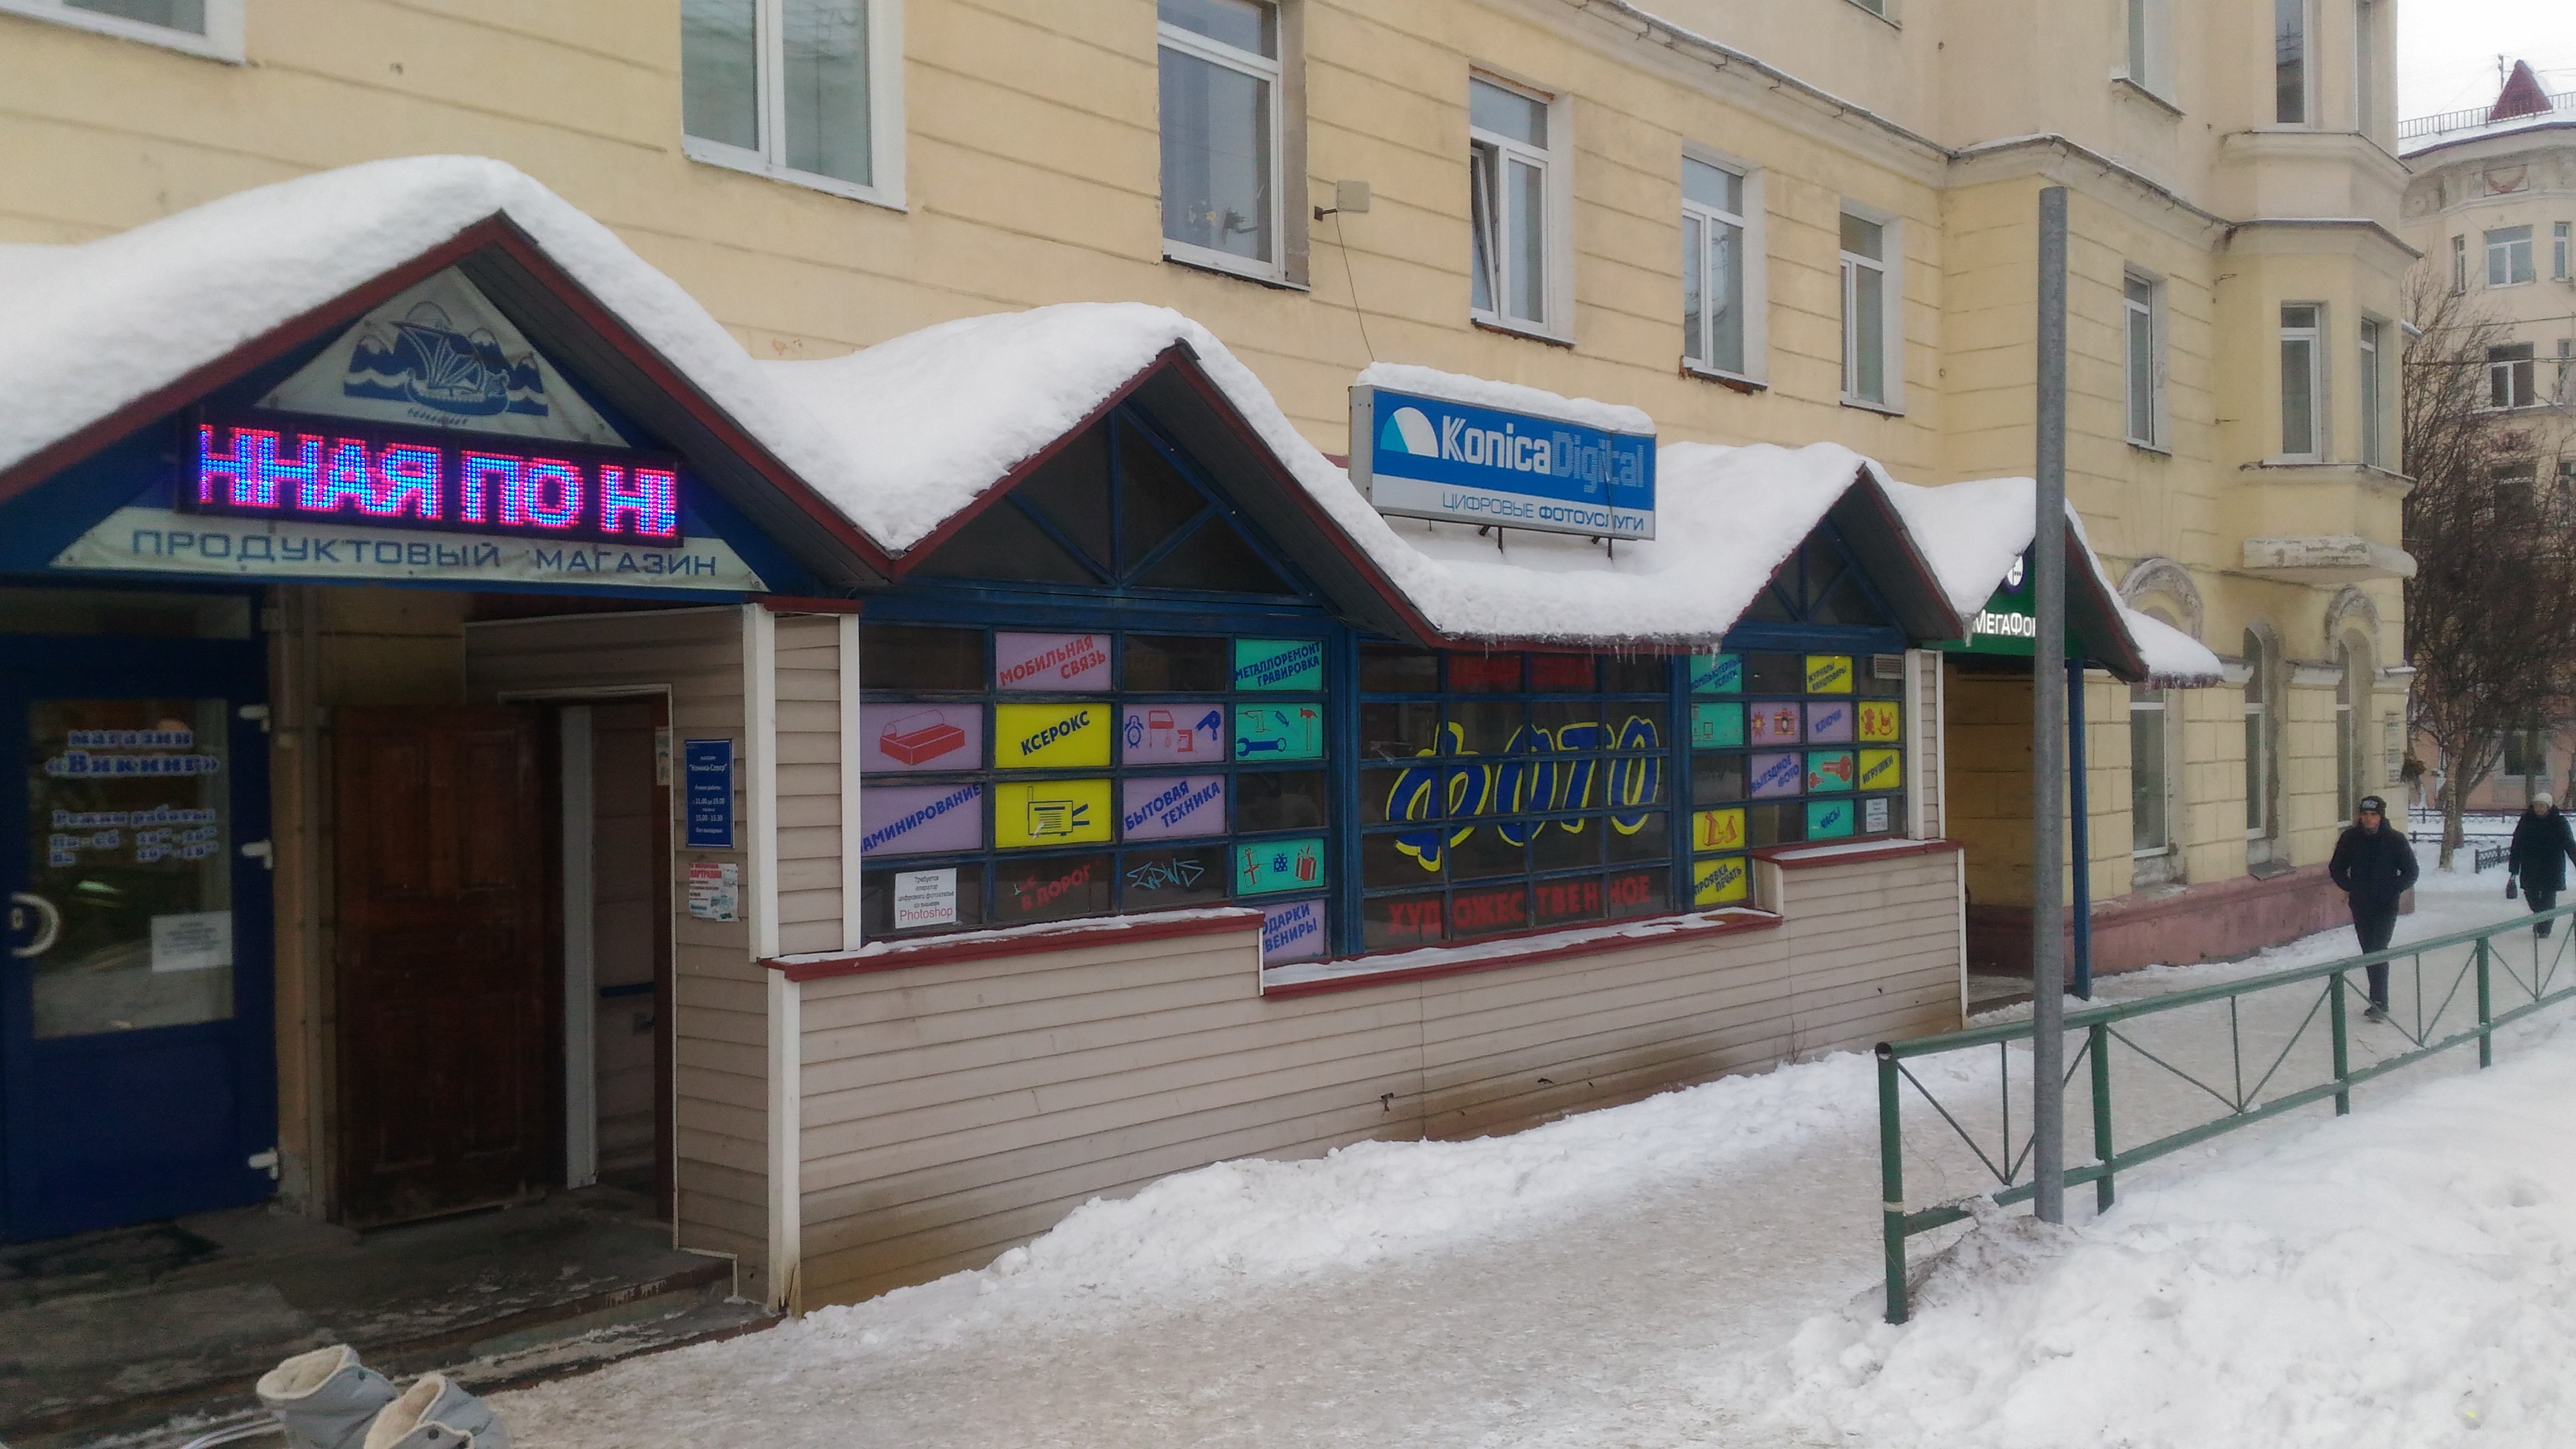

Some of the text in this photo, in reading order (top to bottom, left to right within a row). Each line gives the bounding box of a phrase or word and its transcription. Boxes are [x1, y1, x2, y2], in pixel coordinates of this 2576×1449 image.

[461, 449, 584, 529] ПО
[1442, 492, 1645, 531] ЦИФРОВЫЕ ФОТОУСЛУГИ
[132, 528, 716, 576] ПРОДУКТОВЫЙ МАГАЗИН
[1973, 608, 2036, 638] МЕГАФО
[999, 635, 1094, 687] МОБИЛЬНАЯ
[1060, 650, 1106, 679] СВЯЗЬ
[1235, 641, 1320, 681] МЕТАЛЛОРЕМОНТ
[1257, 655, 1320, 687] ГРАВИРОВКА
[1020, 711, 1091, 757] КСЕРОКС
[1750, 754, 1792, 792] ВЫЕЗДНОЕ
[1778, 764, 1799, 787] ФОТО
[1862, 754, 1894, 784] ИГРУШКИ
[861, 784, 982, 853] АМИНИРОВАНИЕ
[1124, 780, 1190, 831] БЫТОВАЯ
[1160, 781, 1221, 828] ТЕХНИКА
[1036, 860, 1094, 907] ДОРОГ
[1693, 863, 1728, 896] ПРОЯВКА
[1716, 866, 1742, 892] ПЕЧАТЬ
[899, 907, 953, 921] Photoshop
[1262, 902, 1311, 936] ОДАРКИ
[1265, 917, 1318, 953] ВЕНИРЫ
